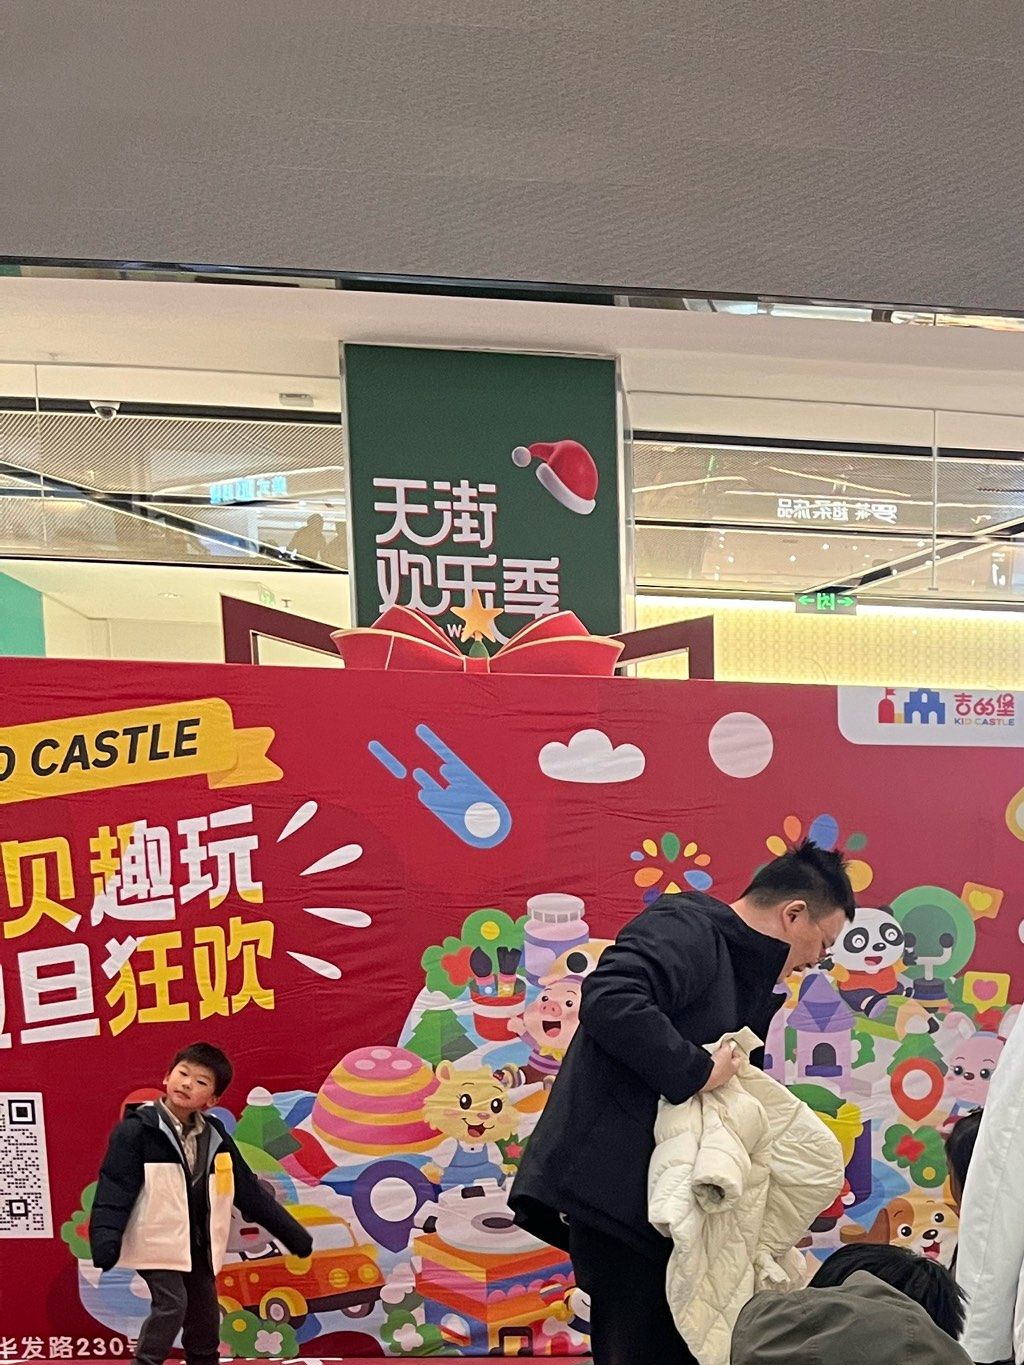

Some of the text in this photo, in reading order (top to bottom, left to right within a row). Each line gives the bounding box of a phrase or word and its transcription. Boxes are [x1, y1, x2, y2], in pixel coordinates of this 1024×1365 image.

[373, 477, 498, 549] 天街
[376, 548, 560, 621] 欢乐季
[31, 717, 201, 777] CASTLE
[974, 718, 1016, 727] CASTLE
[0, 803, 264, 939] 贝趣玩
[0, 916, 275, 1049] 旦狂欢
